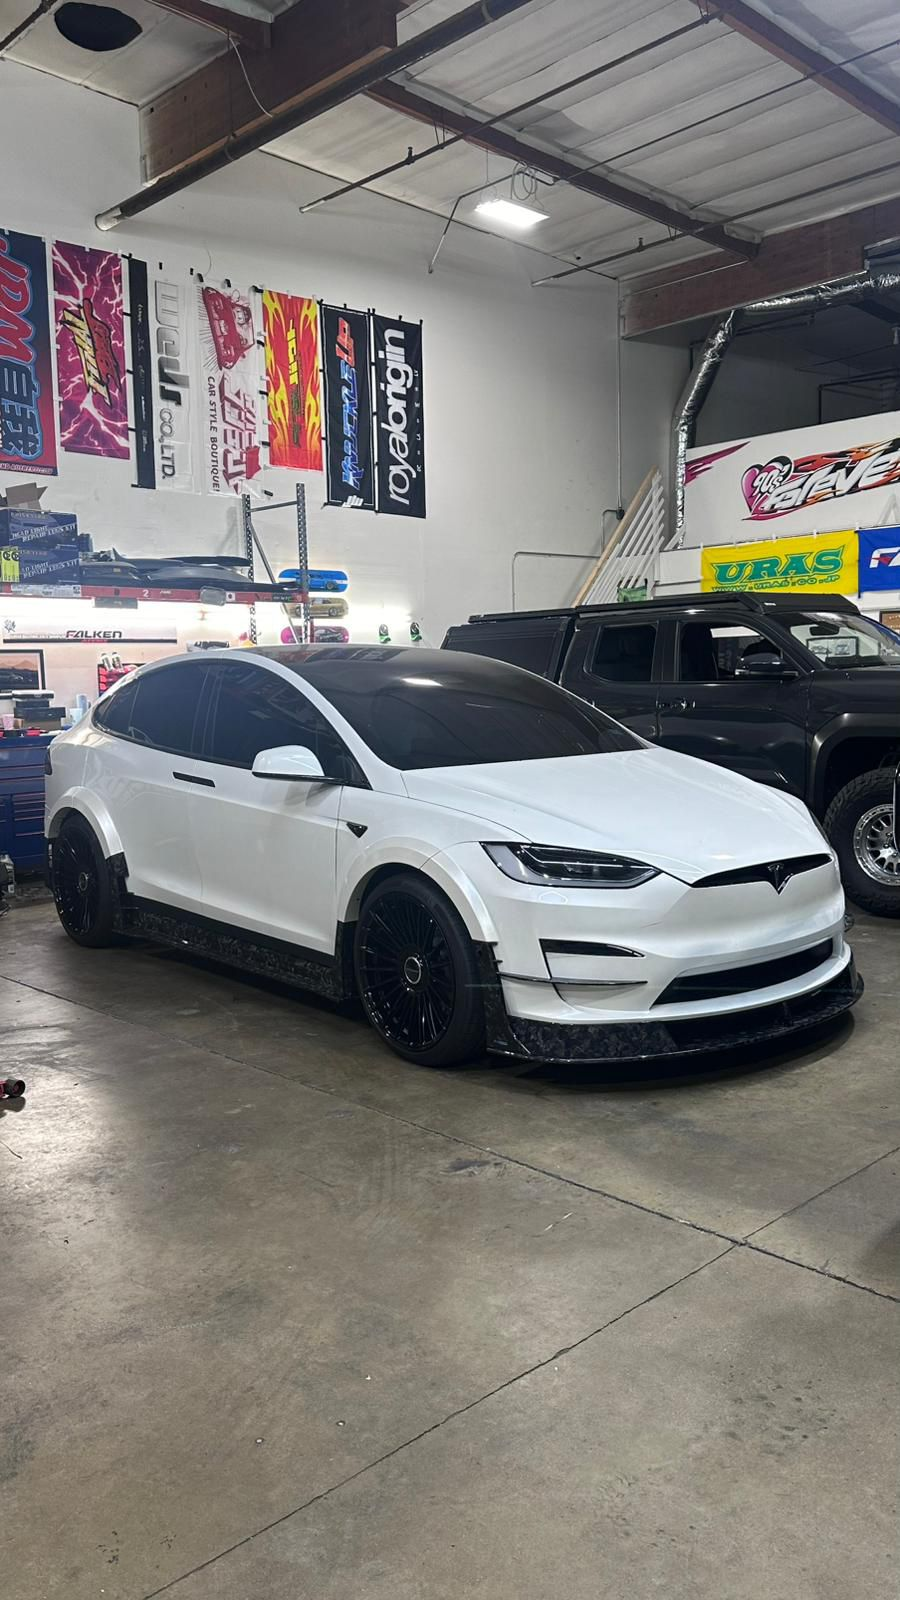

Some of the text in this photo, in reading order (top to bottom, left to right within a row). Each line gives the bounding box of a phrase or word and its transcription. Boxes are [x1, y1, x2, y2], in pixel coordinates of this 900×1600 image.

[207, 376, 220, 492] CAR STYLE BOUTIQUE!
[711, 545, 845, 585] URAS
[142, 589, 149, 598] 2
[65, 630, 122, 638] FALKEN
